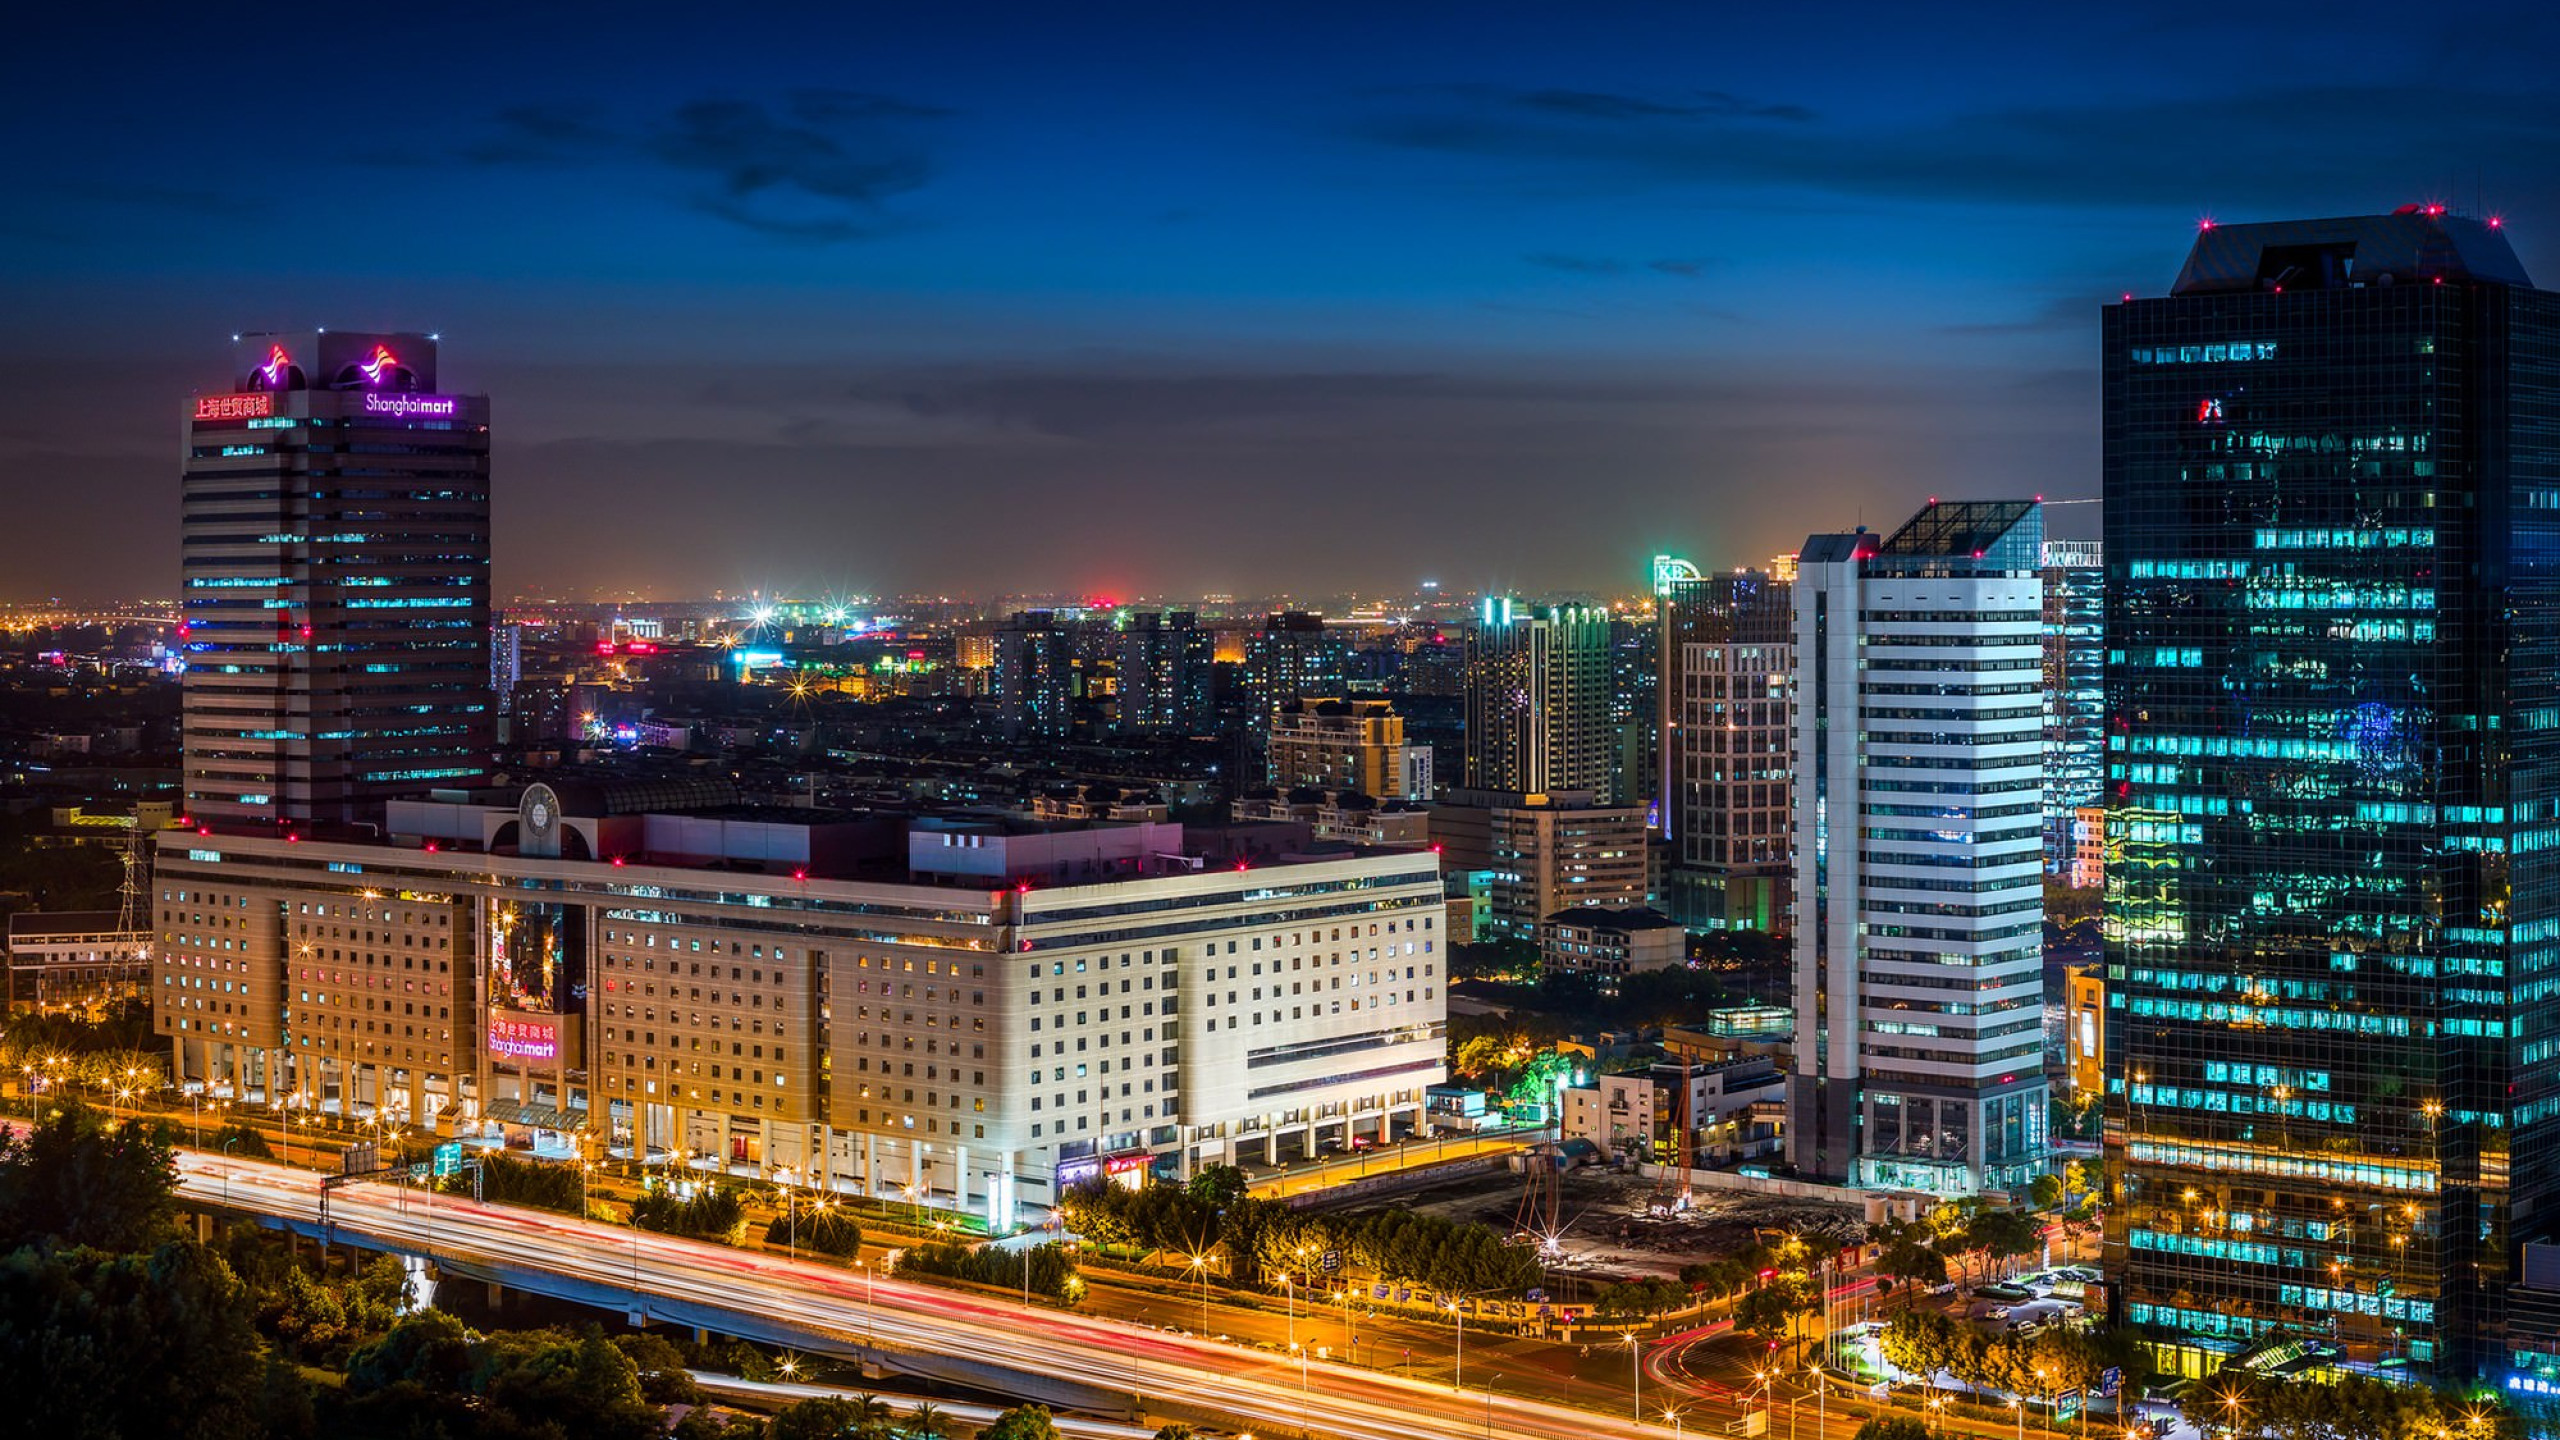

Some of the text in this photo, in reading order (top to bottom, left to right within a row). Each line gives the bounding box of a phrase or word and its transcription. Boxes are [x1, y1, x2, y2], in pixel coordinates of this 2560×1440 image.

[196, 396, 268, 418] 上海世贸商城
[366, 393, 453, 416] Shanghaimart
